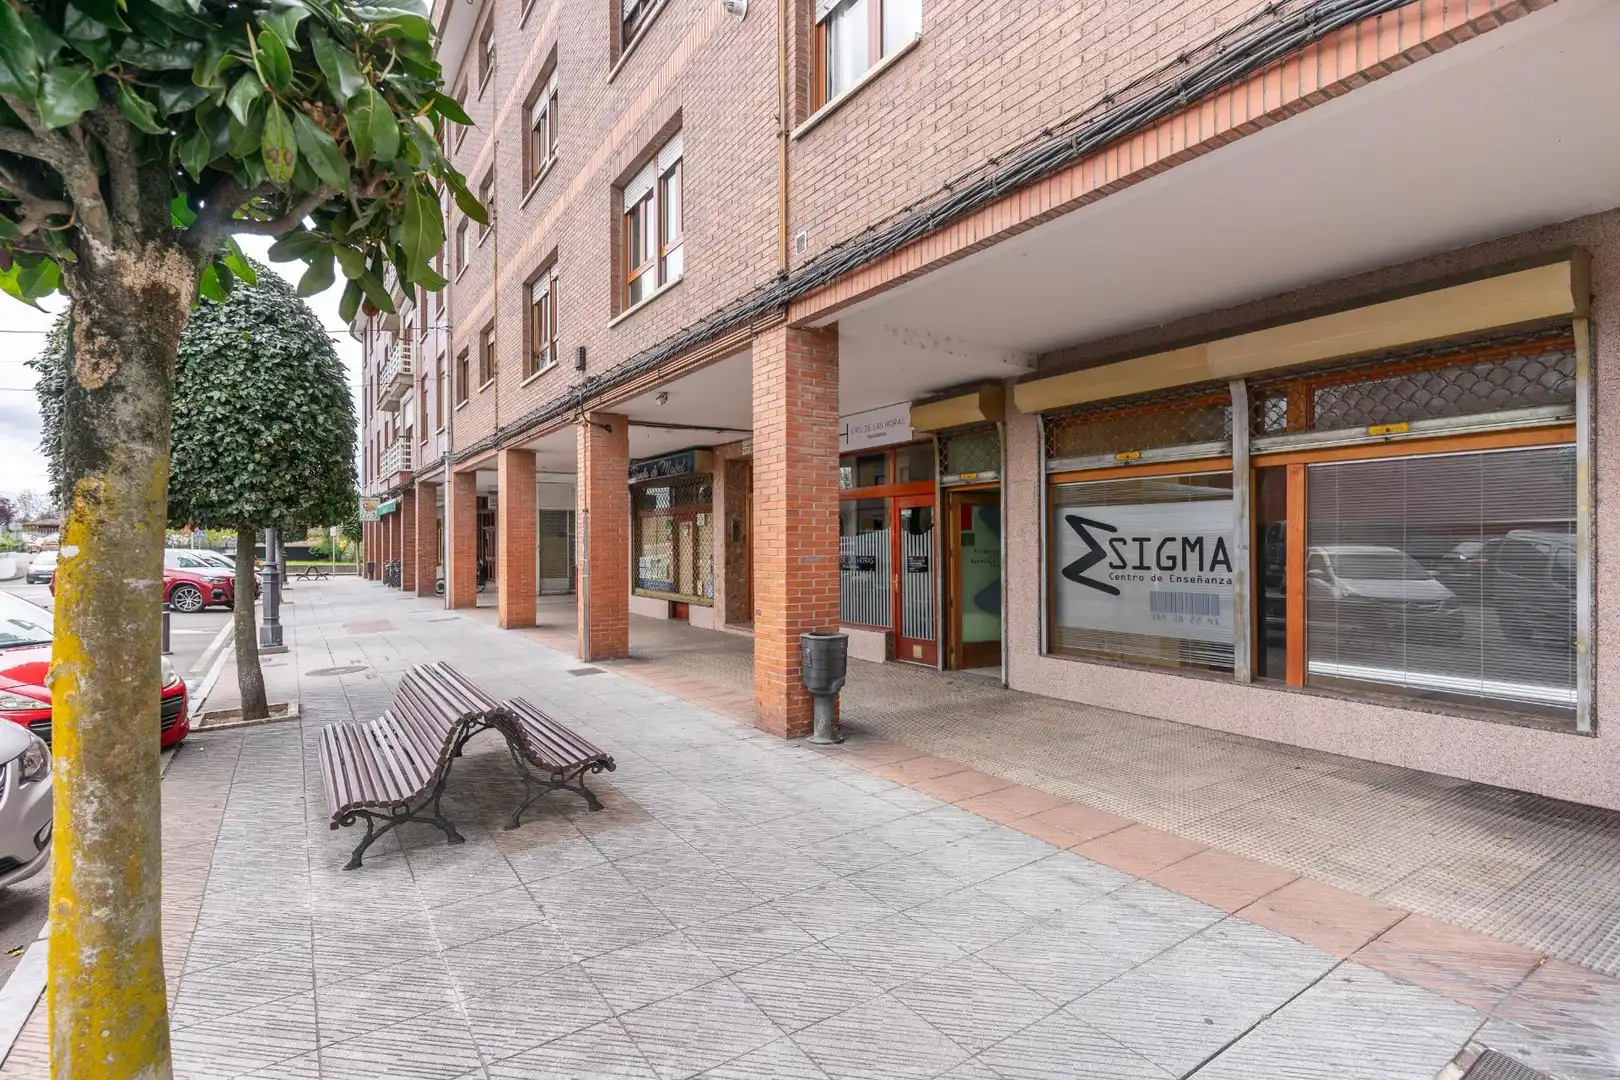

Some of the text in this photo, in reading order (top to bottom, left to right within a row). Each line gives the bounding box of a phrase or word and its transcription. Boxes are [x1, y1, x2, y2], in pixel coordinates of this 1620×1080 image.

[1108, 536, 1233, 573] SIGMA
[1108, 572, 1233, 585] Centro de Enseñanza
